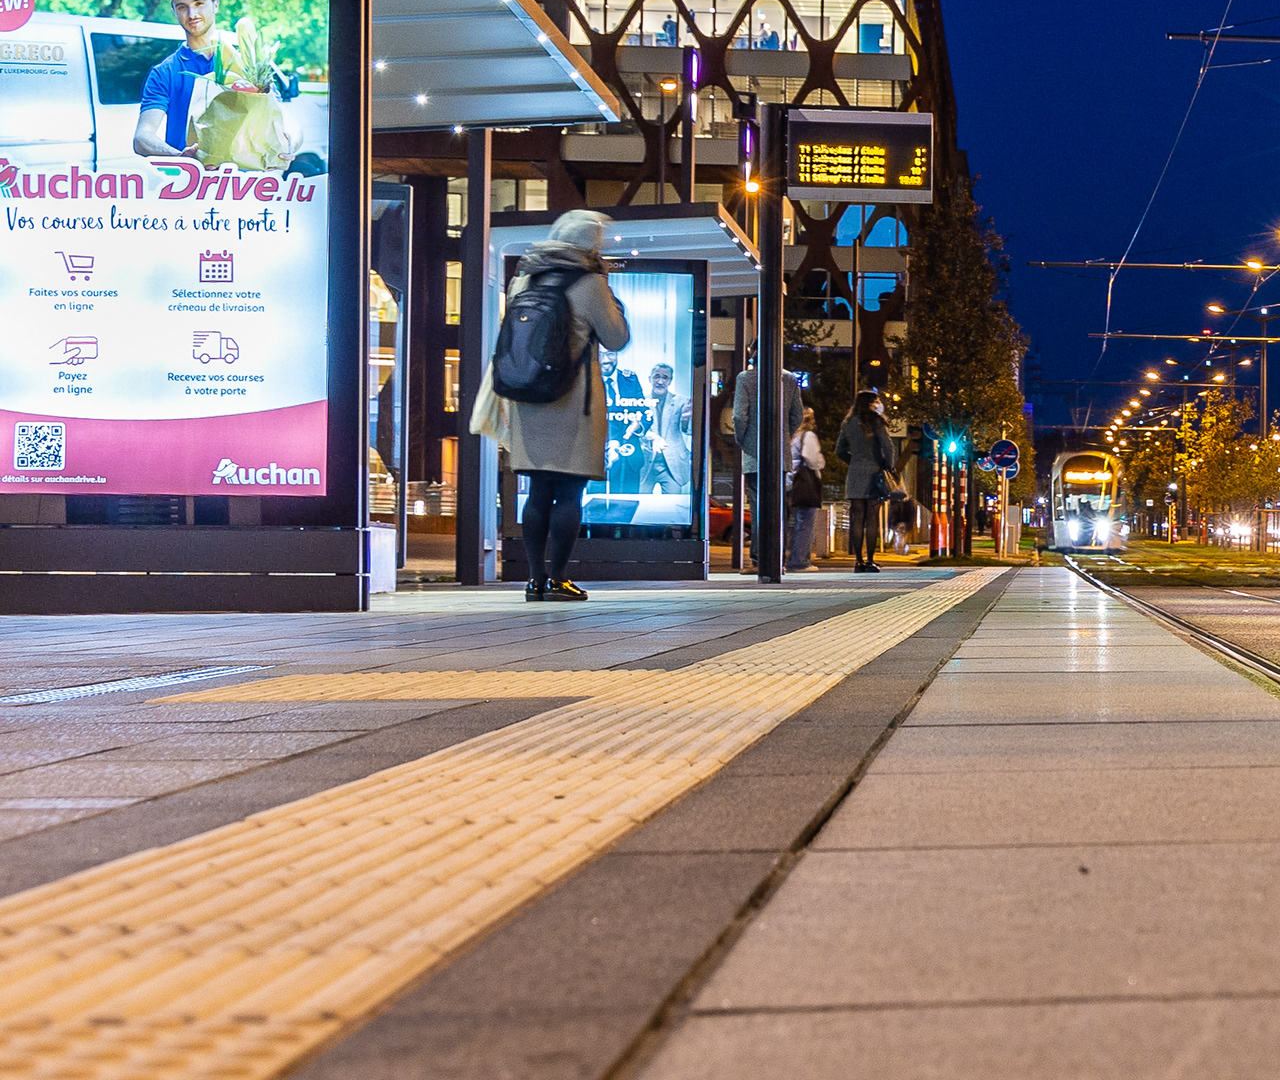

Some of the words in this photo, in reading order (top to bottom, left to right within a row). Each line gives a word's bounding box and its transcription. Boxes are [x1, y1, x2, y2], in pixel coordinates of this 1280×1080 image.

[7, 206, 34, 231] Vos
[42, 215, 105, 230] courses
[110, 204, 168, 231] livrées
[174, 216, 188, 231] à
[193, 207, 231, 231] votre
[238, 208, 278, 240] porte
[29, 287, 58, 297] Faites
[81, 290, 118, 298] courses
[172, 288, 233, 299] Sélectionnez
[235, 290, 261, 299] votre
[69, 301, 94, 312] ligne
[168, 302, 207, 312] créneau
[209, 303, 221, 312] de
[222, 303, 265, 313] livraison
[58, 371, 88, 382] Payez
[167, 372, 206, 382] Recevez
[208, 374, 225, 382] vos
[226, 374, 265, 383] courses
[53, 386, 65, 394] en
[67, 385, 93, 396] ligne
[185, 385, 192, 395] à
[194, 386, 219, 396] votre
[220, 386, 247, 397] porte
[616, 393, 660, 407] lancer
[606, 409, 643, 424] rojet
[212, 458, 321, 486] Auchan
[2, 474, 29, 483] détails
[44, 474, 107, 484] auchandrive.lu
